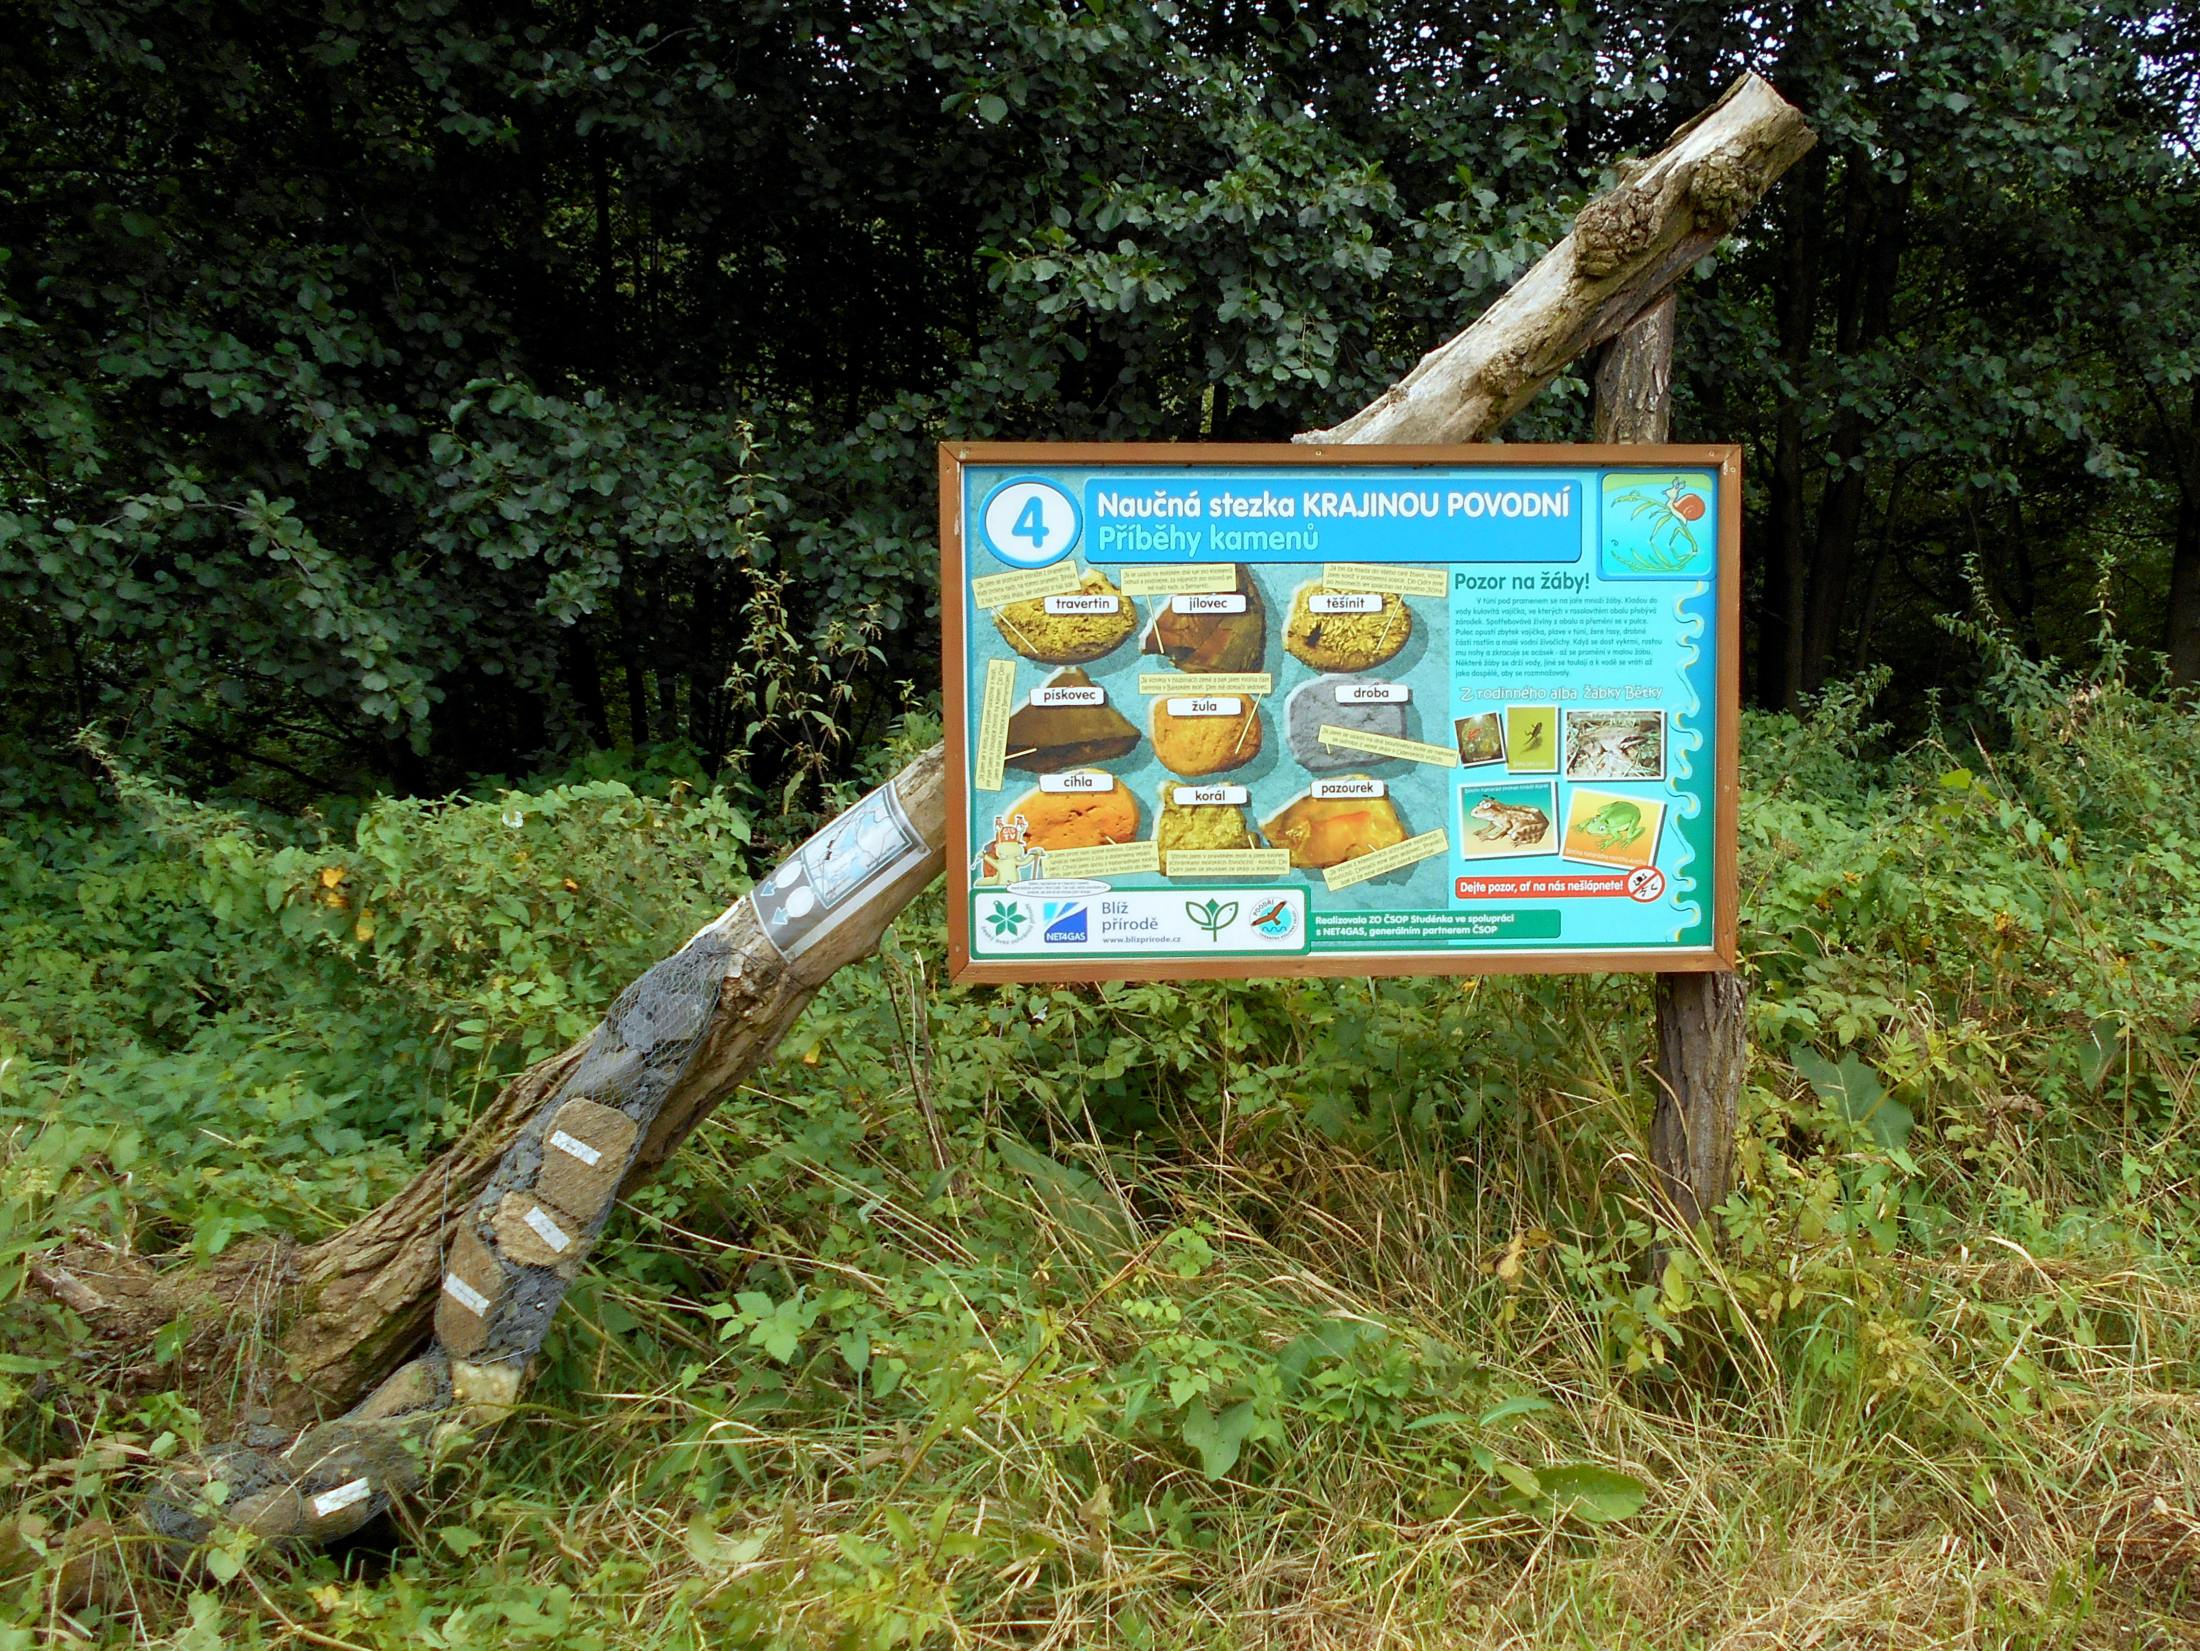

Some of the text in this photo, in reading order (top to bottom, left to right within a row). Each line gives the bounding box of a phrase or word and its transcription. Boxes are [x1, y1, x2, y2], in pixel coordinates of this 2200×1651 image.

[1098, 485, 1572, 518] Naučná stezka KRAJINOU POVODNÍ
[1011, 495, 1050, 548] 4
[1099, 523, 1319, 558] Příběhy kamenů
[1455, 573, 1507, 590] Pozor
[1511, 577, 1539, 590] na
[1541, 571, 1590, 594] žáby!
[1055, 598, 1110, 609] travertin
[1189, 596, 1228, 611] jílovec
[1326, 596, 1365, 609] těšínit
[1043, 688, 1096, 702] pískovec
[1353, 687, 1390, 699] droba
[1460, 687, 1474, 701] Z
[1476, 685, 1546, 700] rodinného
[1550, 686, 1578, 700] alba
[1191, 700, 1218, 712] žula
[1063, 776, 1093, 788] cihla
[1195, 790, 1226, 802] korál
[1321, 783, 1374, 797] pazourek
[1460, 882, 1486, 894] Dejte
[1488, 883, 1518, 893] pozor,
[1533, 883, 1546, 891] na
[1549, 881, 1566, 891] nás
[1568, 880, 1624, 893] nešlápnete!
[1102, 901, 1129, 914] Blíž
[1102, 917, 1159, 933] přírodě
[1315, 916, 1367, 924] Realizovala
[1369, 916, 1382, 924] ZO
[1384, 913, 1409, 923] ČSOP
[1467, 913, 1514, 924] spolupráci
[1046, 932, 1086, 941] NET4GAS
[1323, 927, 1367, 936] NET4GAS,
[1369, 926, 1420, 937] generálním
[1422, 926, 1471, 936] partnerem
[1472, 924, 1497, 933] ČSOP
